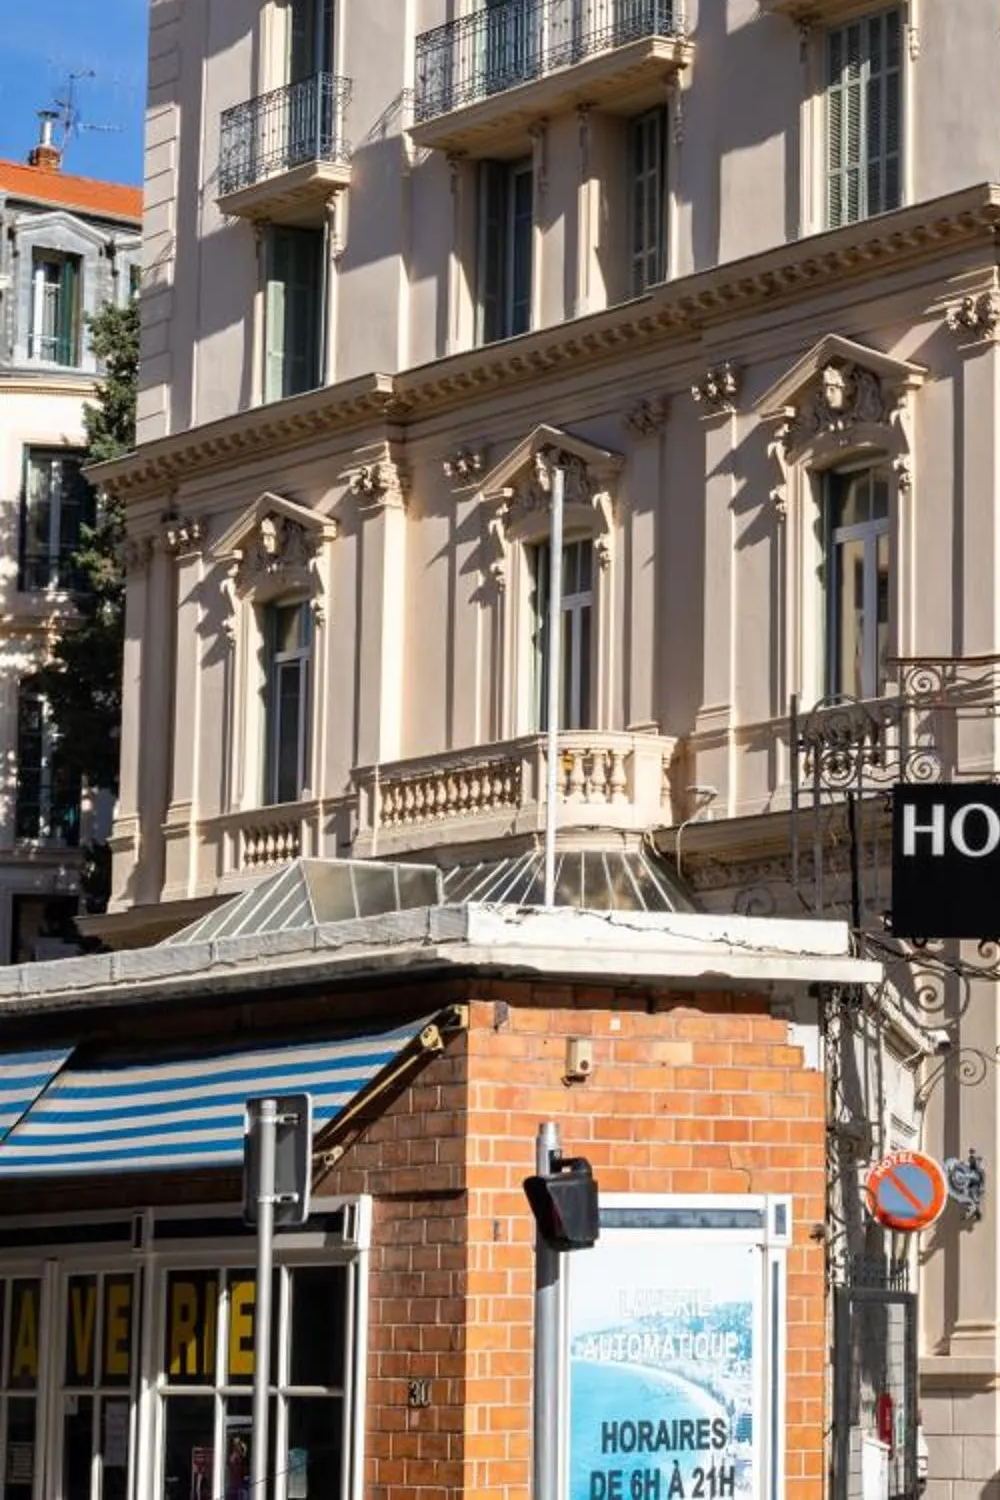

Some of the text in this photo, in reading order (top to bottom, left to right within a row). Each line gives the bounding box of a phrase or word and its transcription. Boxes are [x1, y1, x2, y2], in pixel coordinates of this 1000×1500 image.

[583, 1332, 739, 1360] AUTOMATIQUE
[601, 1418, 728, 1454] HORAIRES
[589, 1459, 735, 1500] DE 6H À 21H
